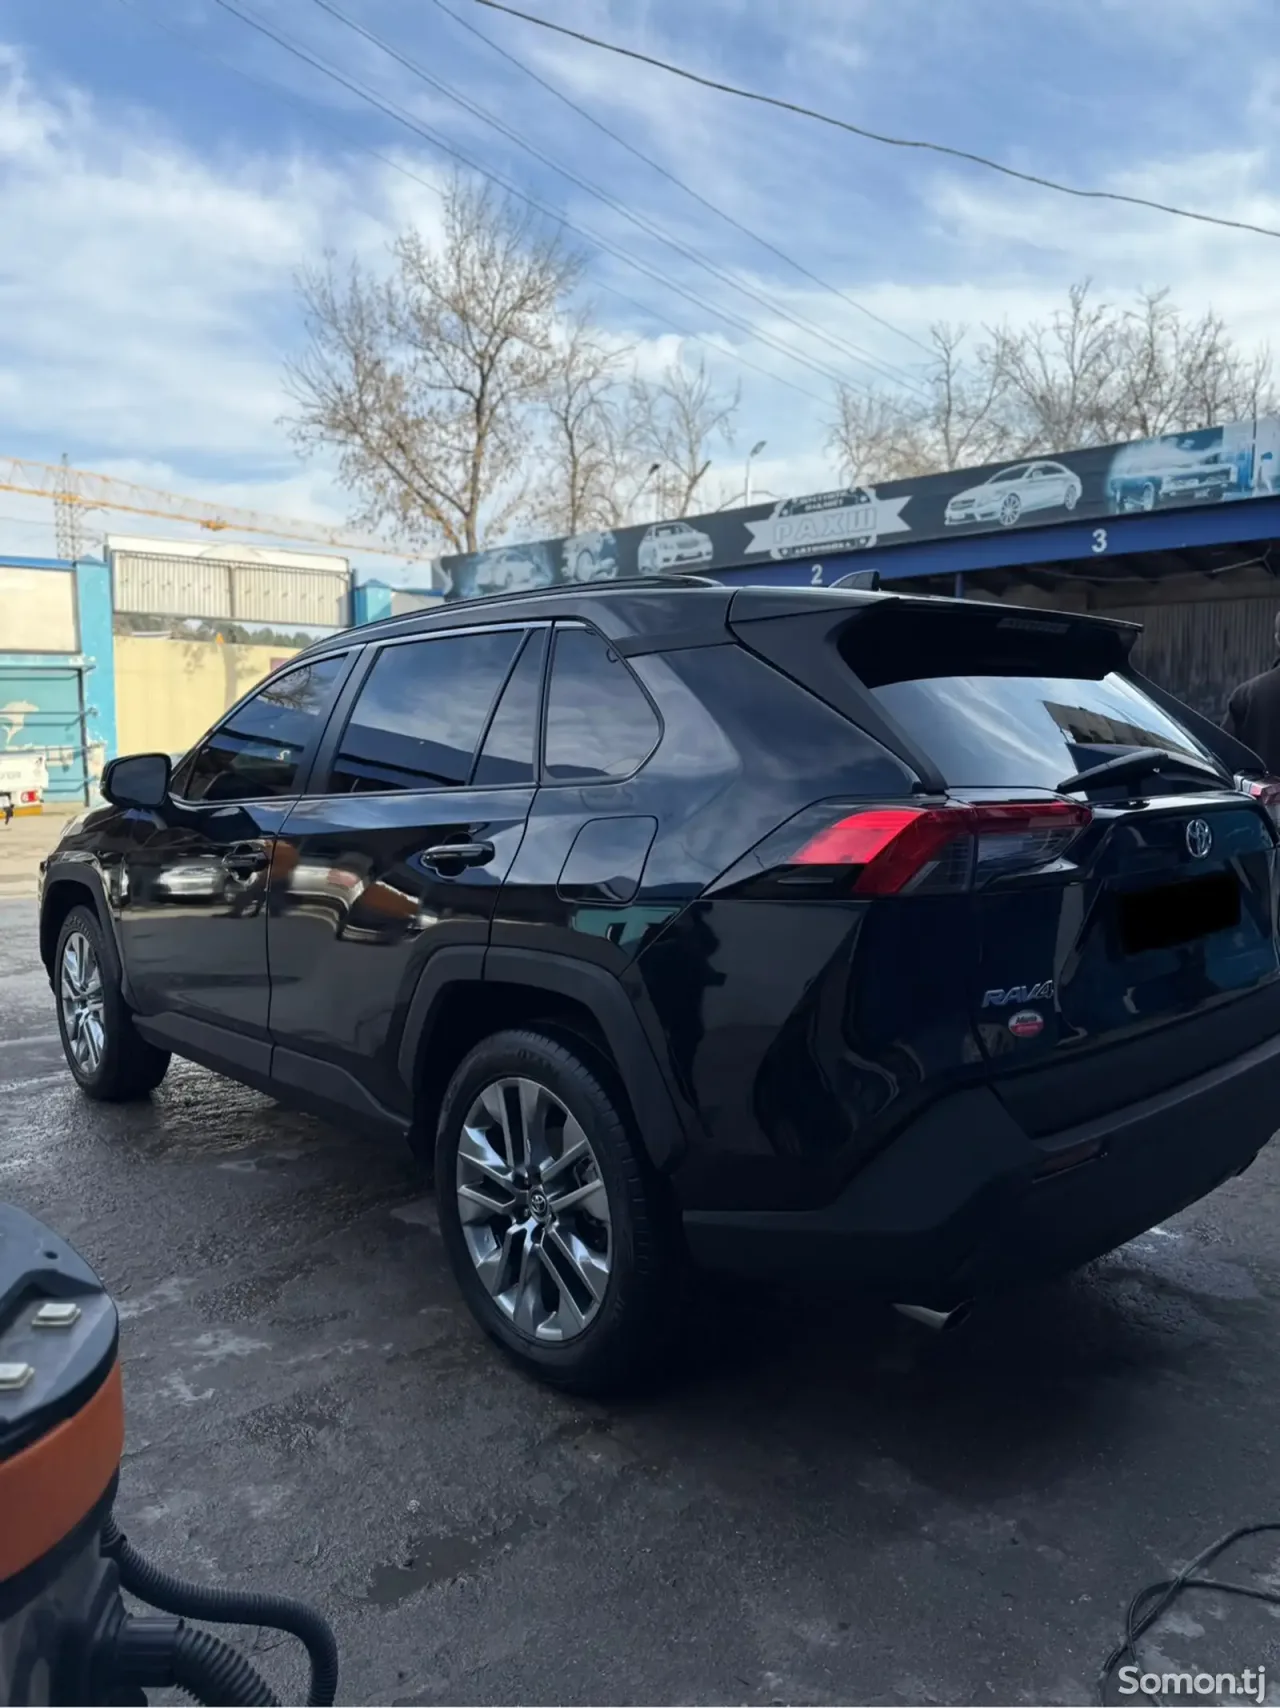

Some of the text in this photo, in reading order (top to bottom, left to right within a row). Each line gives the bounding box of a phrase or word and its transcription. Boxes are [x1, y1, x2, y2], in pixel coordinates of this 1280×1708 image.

[1091, 528, 1107, 552] 3
[811, 564, 823, 585] 2
[981, 979, 1054, 1008] RAV4
